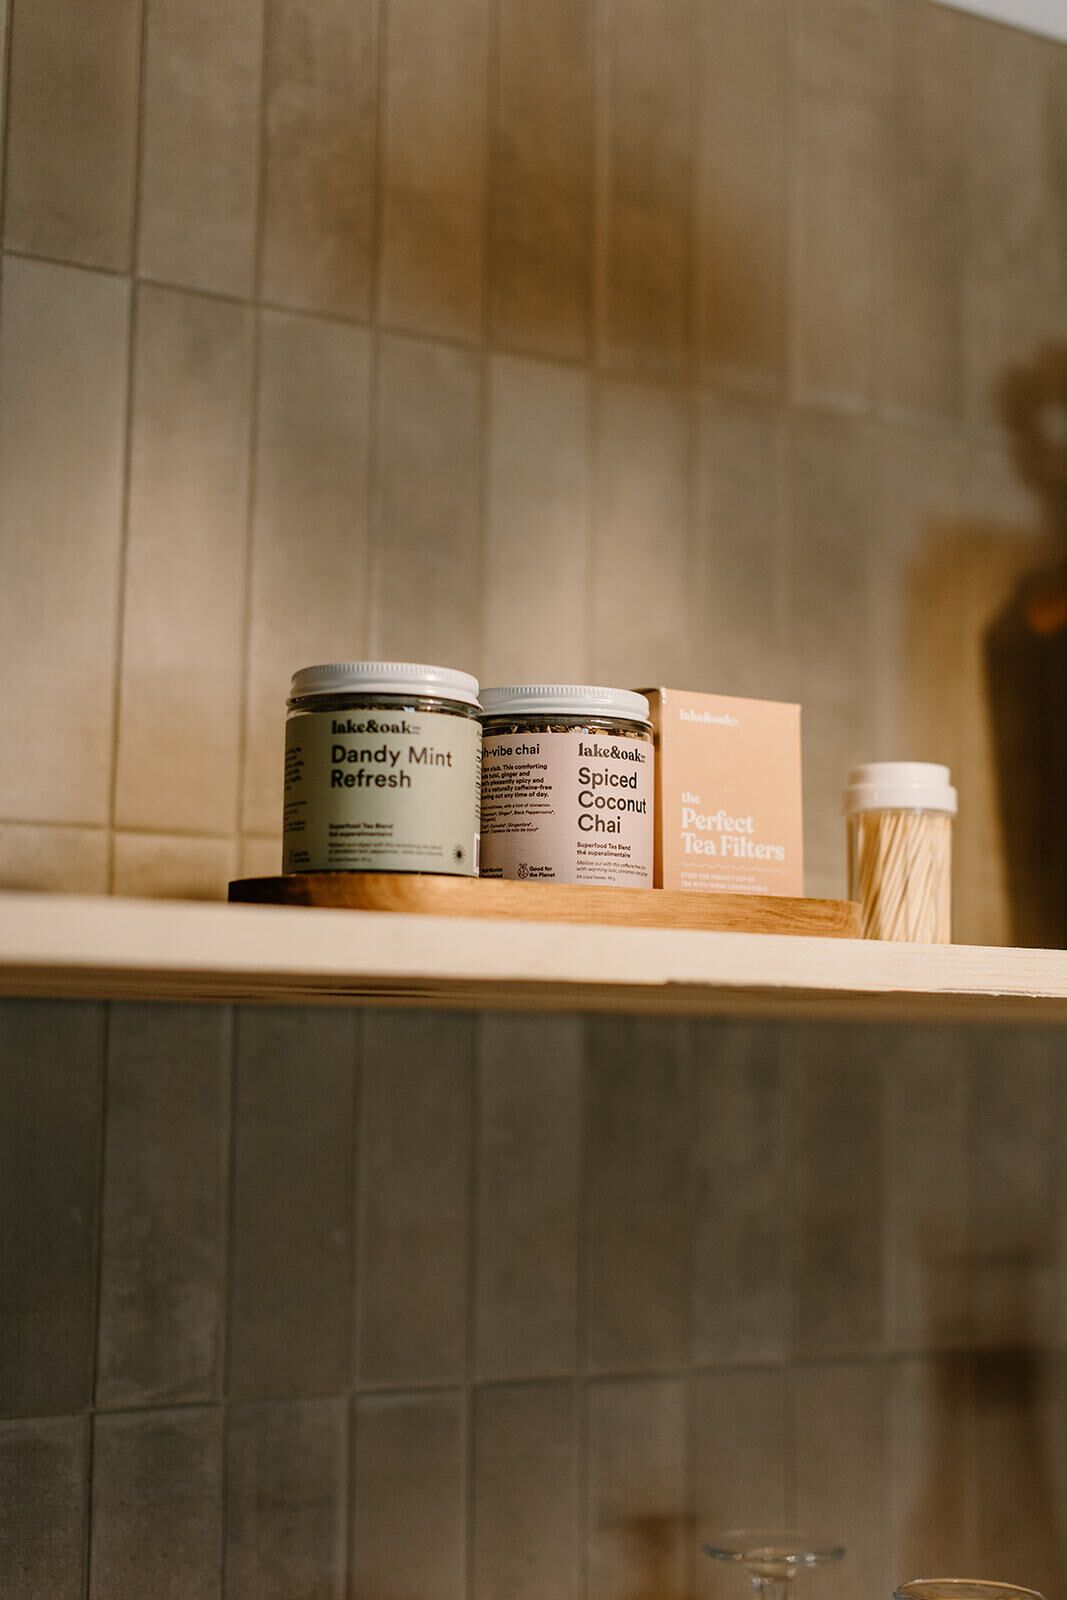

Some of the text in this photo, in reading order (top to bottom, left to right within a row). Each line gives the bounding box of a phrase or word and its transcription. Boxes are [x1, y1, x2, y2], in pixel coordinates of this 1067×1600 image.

[331, 745, 453, 768] Dandy Mint
[515, 743, 540, 755] chai
[331, 769, 412, 789] Refresh
[501, 771, 518, 779] ginger
[515, 777, 532, 785] spicy
[578, 766, 637, 789] Spiced
[514, 784, 553, 792] caffeine-free
[681, 790, 701, 805] the
[577, 790, 647, 814] Coconut
[577, 813, 621, 834] Chai
[681, 807, 755, 834] Perfect
[577, 841, 607, 849] Superfood
[680, 831, 786, 862] Tea Filters
